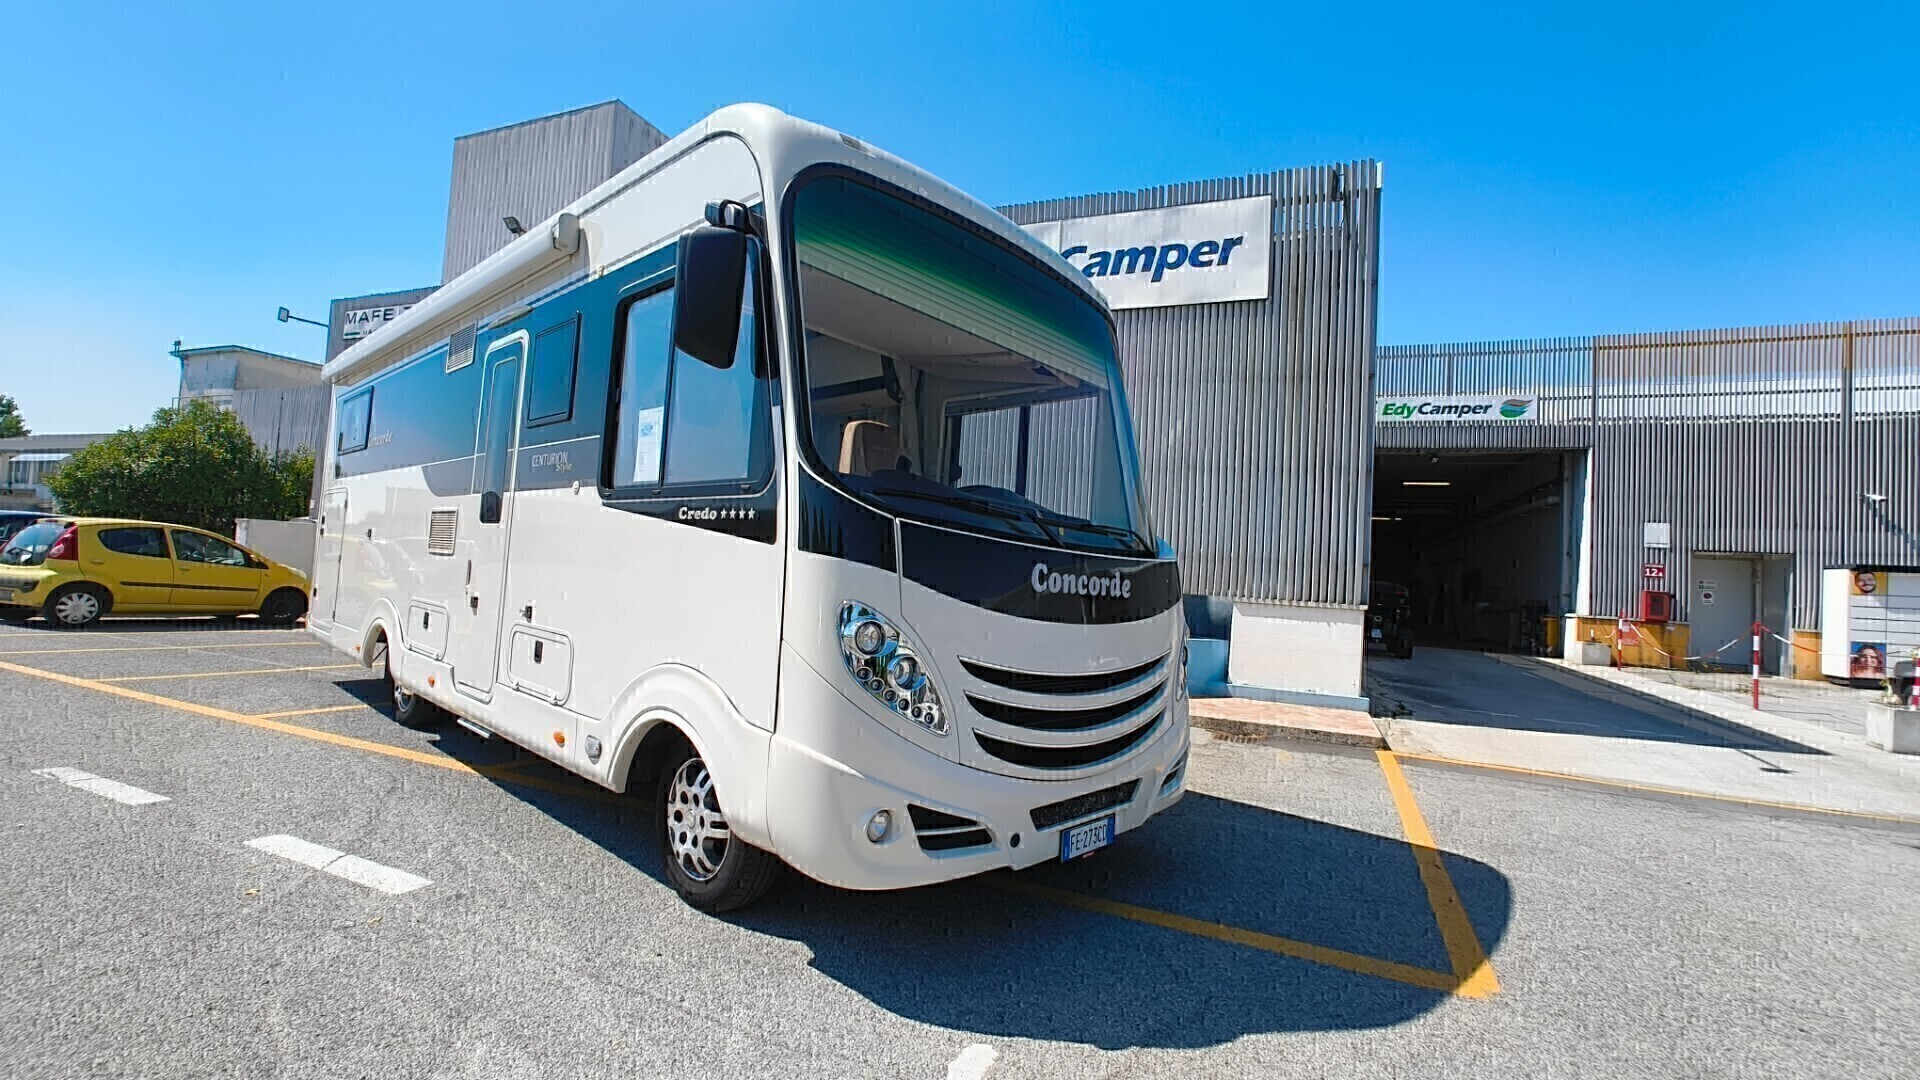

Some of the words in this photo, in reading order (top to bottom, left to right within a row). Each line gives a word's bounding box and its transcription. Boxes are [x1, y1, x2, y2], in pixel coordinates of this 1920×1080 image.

[346, 308, 394, 324] MAFE
[531, 451, 569, 467] CENTURION
[555, 463, 573, 473] Style
[678, 506, 718, 520] Credo
[1031, 562, 1131, 599] Concorde
